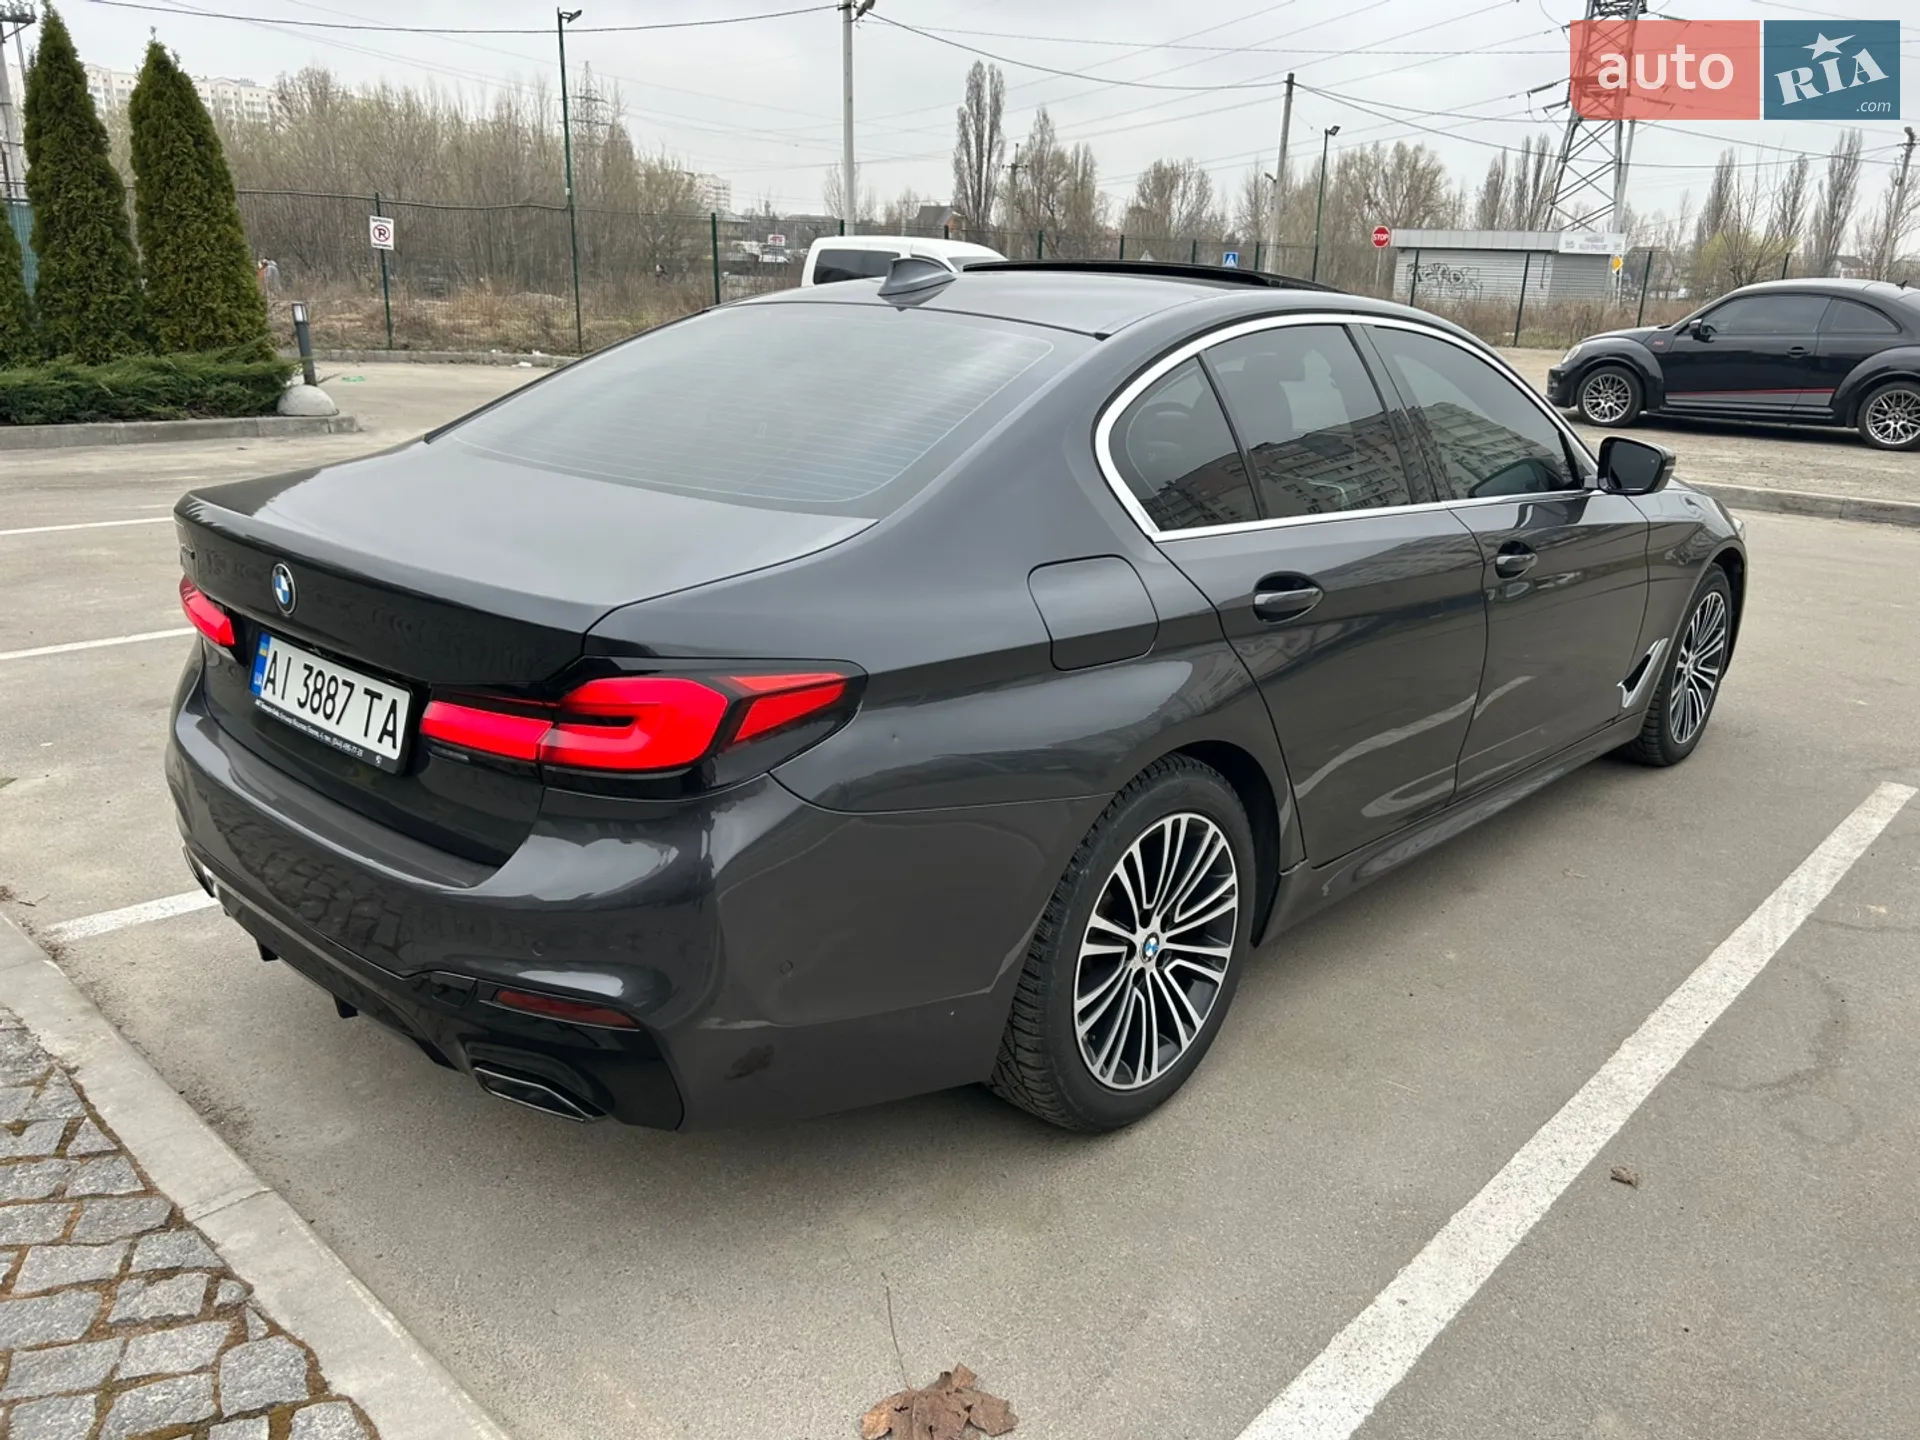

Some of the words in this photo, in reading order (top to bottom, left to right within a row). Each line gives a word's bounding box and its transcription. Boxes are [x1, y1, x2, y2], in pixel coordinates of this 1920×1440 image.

[1373, 233, 1389, 241] STOP
[263, 650, 292, 701] AI
[297, 662, 356, 726] 3887
[363, 687, 398, 749] TA
